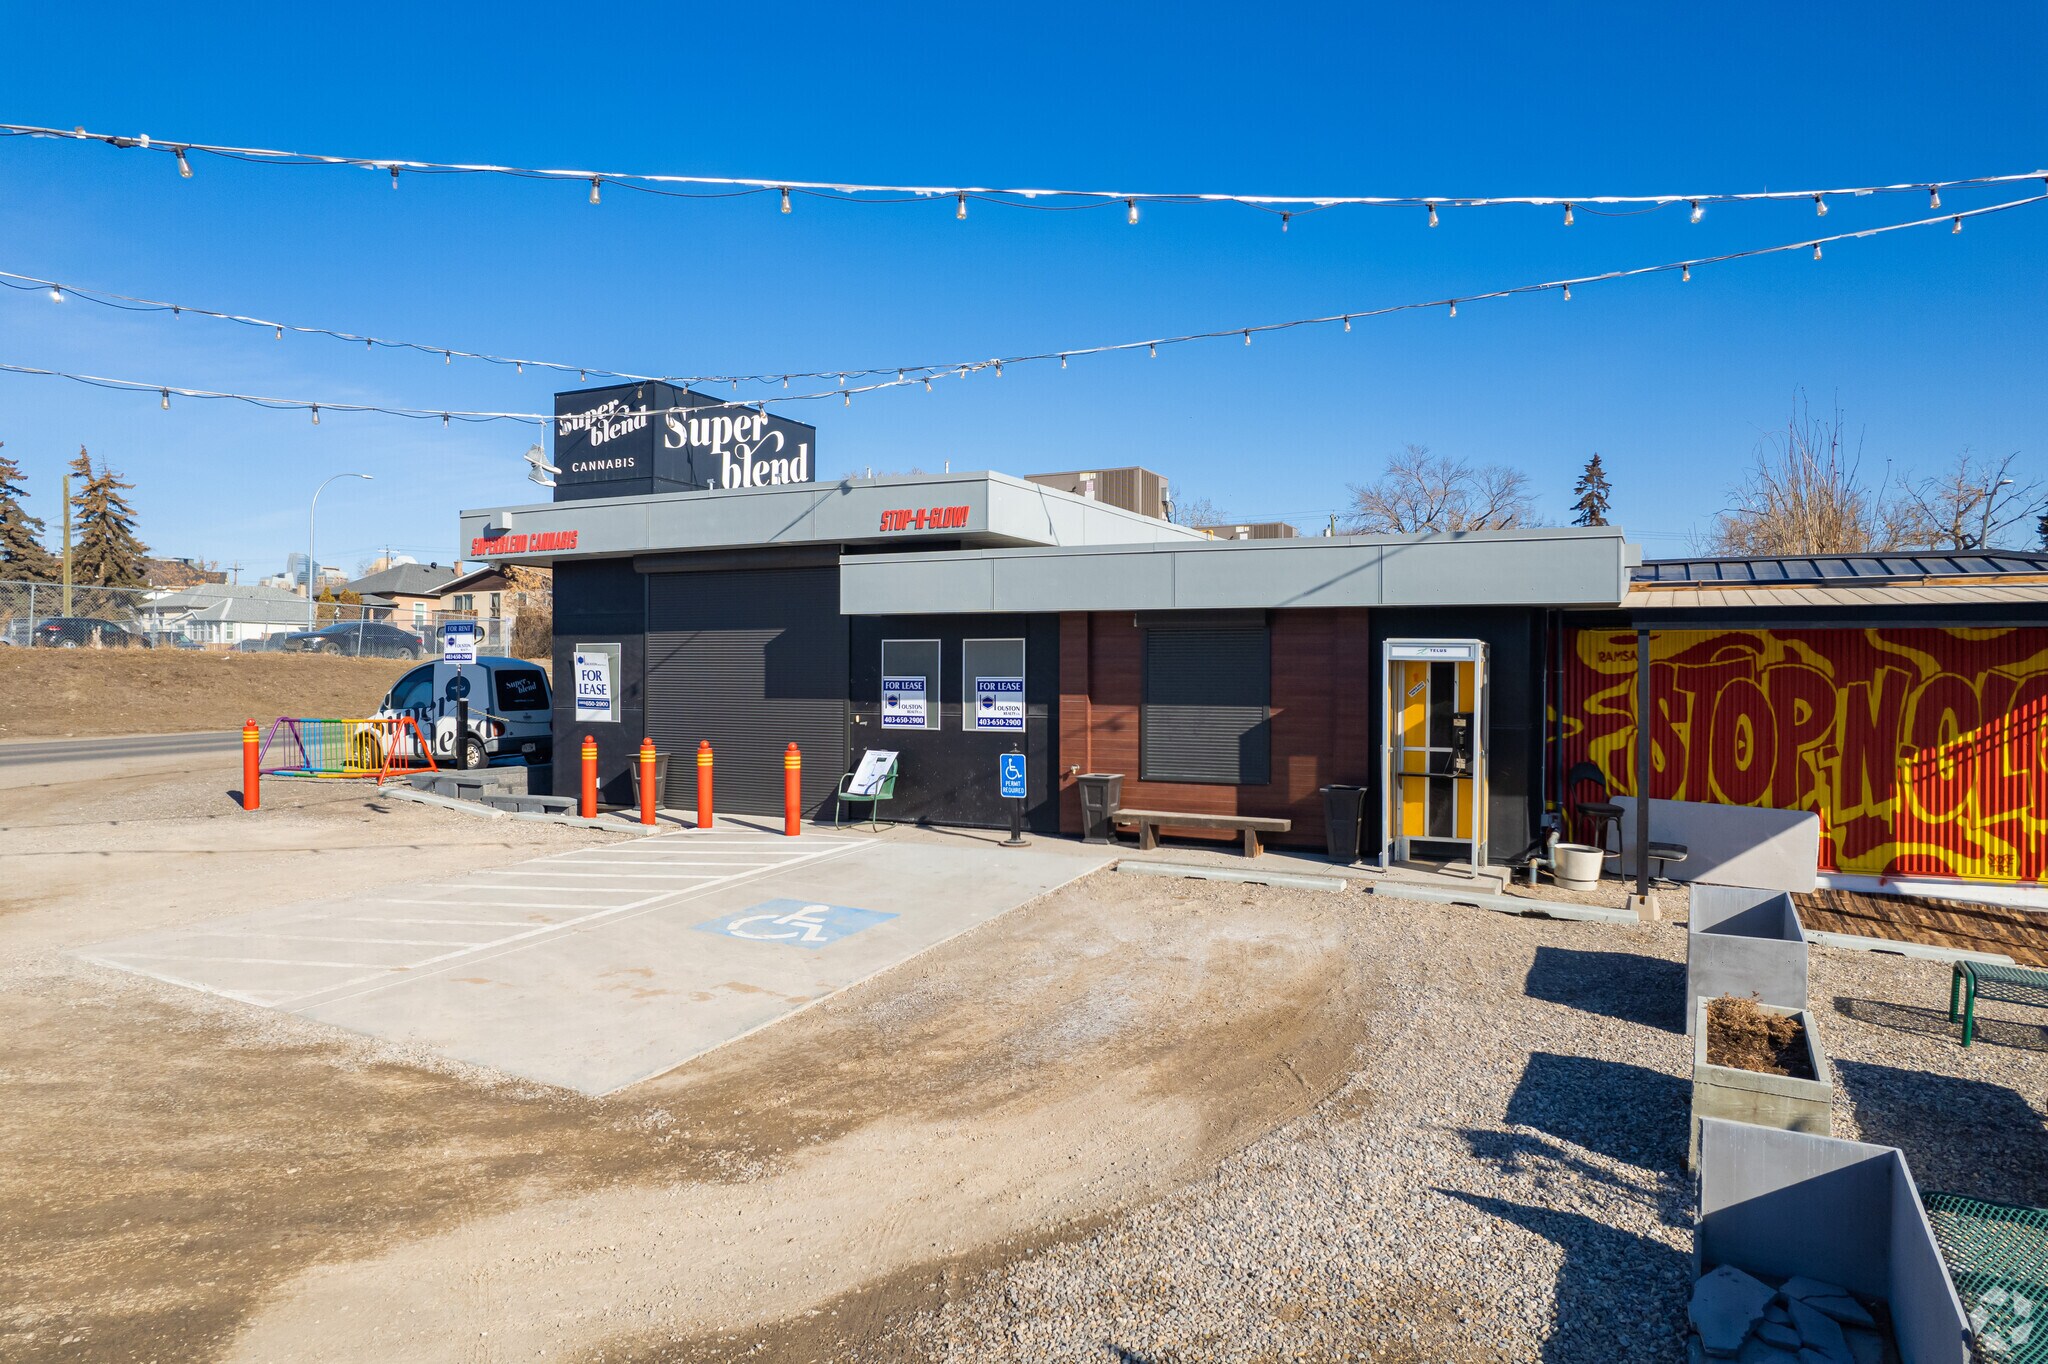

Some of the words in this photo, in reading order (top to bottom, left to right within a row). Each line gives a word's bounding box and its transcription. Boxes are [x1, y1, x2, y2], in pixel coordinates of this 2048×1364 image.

[559, 399, 619, 437] Super
[590, 404, 648, 447] blend
[664, 406, 769, 455] Super
[571, 457, 636, 473] CANNABIS
[720, 430, 809, 489] blend
[880, 505, 970, 532] STOP-N-GLOW!
[471, 534, 529, 557] SUPERBLEND
[529, 530, 579, 553] CANNABIS
[581, 669, 602, 681] FOR
[579, 683, 607, 696] LEASE
[885, 681, 900, 690] FOR
[901, 681, 923, 690] LEASE
[979, 682, 996, 691] FOR
[997, 682, 1021, 691] LEASE
[884, 716, 924, 724] 403-650-2900
[978, 718, 1022, 726] 403-650-2900
[1002, 786, 1025, 794] REQUIRED
